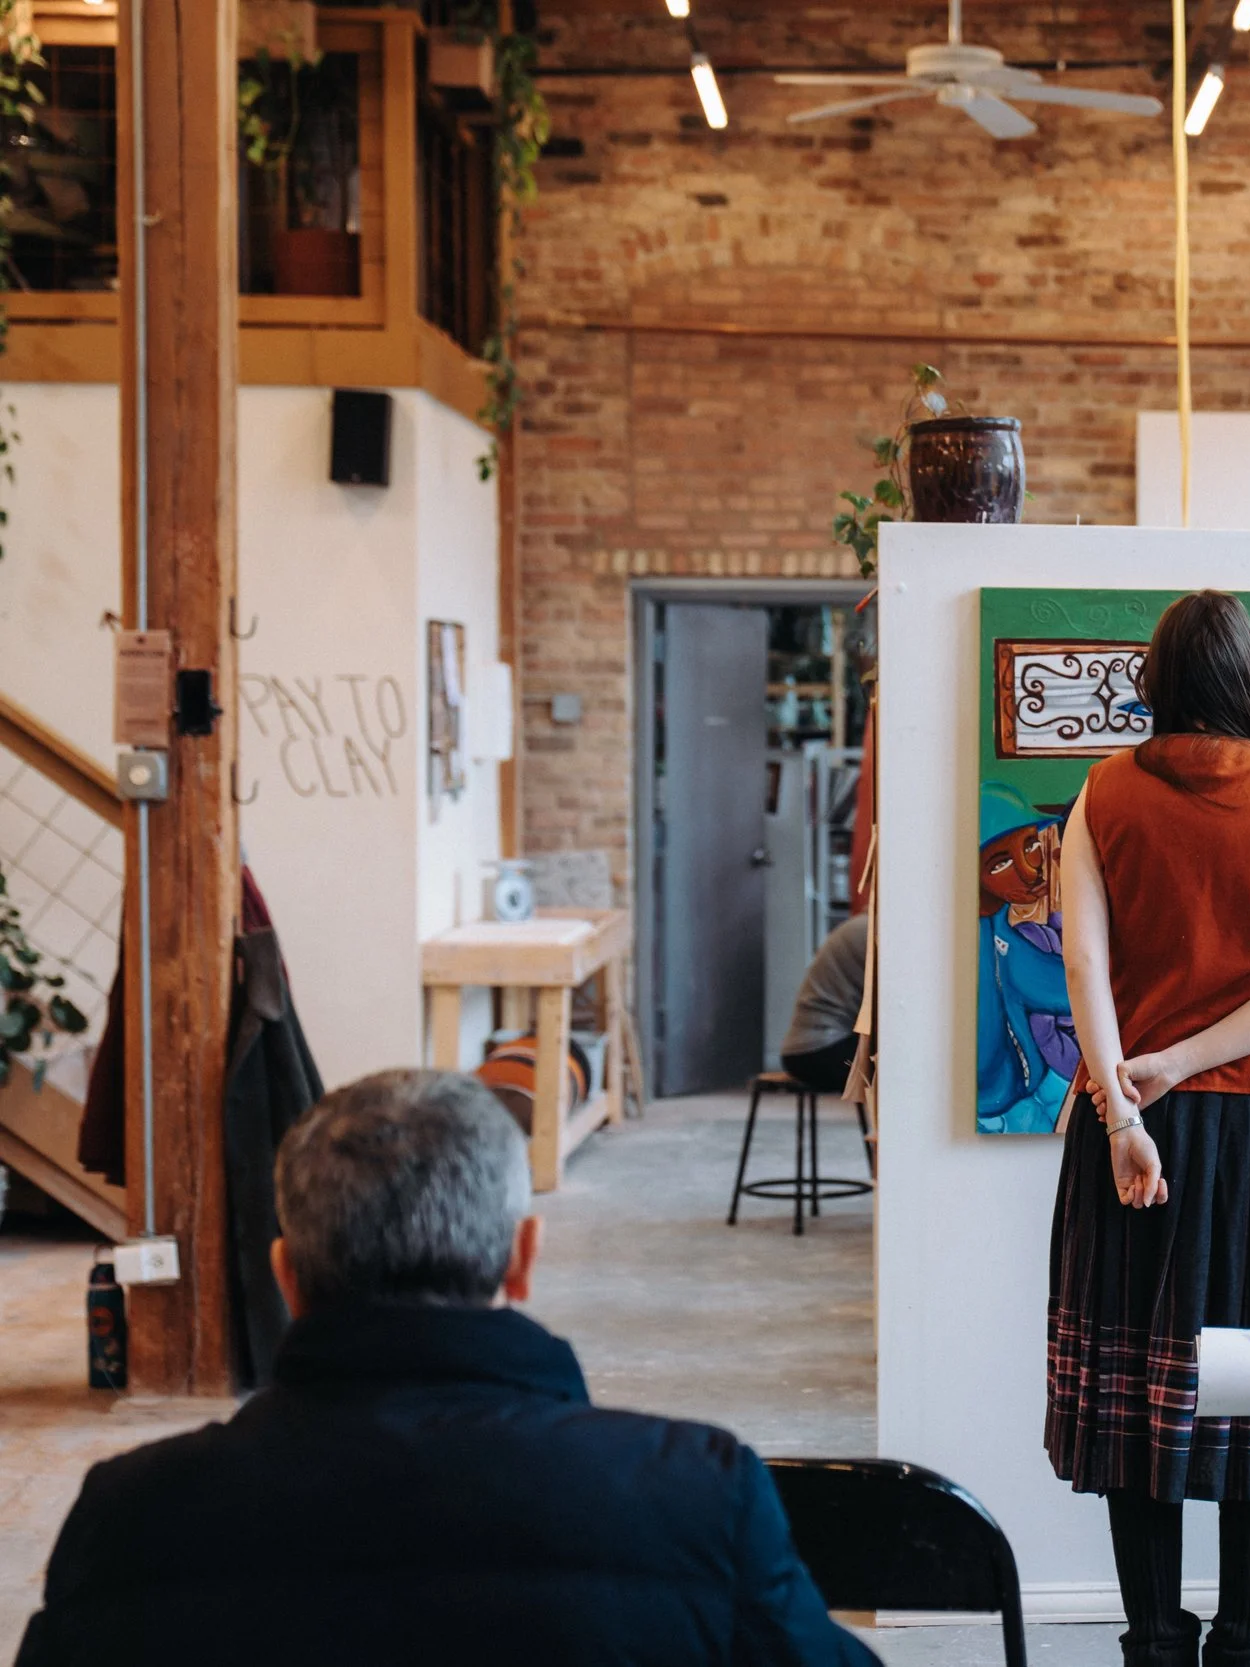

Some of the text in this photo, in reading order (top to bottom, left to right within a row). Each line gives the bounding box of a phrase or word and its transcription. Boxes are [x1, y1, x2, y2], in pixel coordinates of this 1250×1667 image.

[239, 673, 408, 740] PAY TO
[279, 735, 400, 798] CLAY
